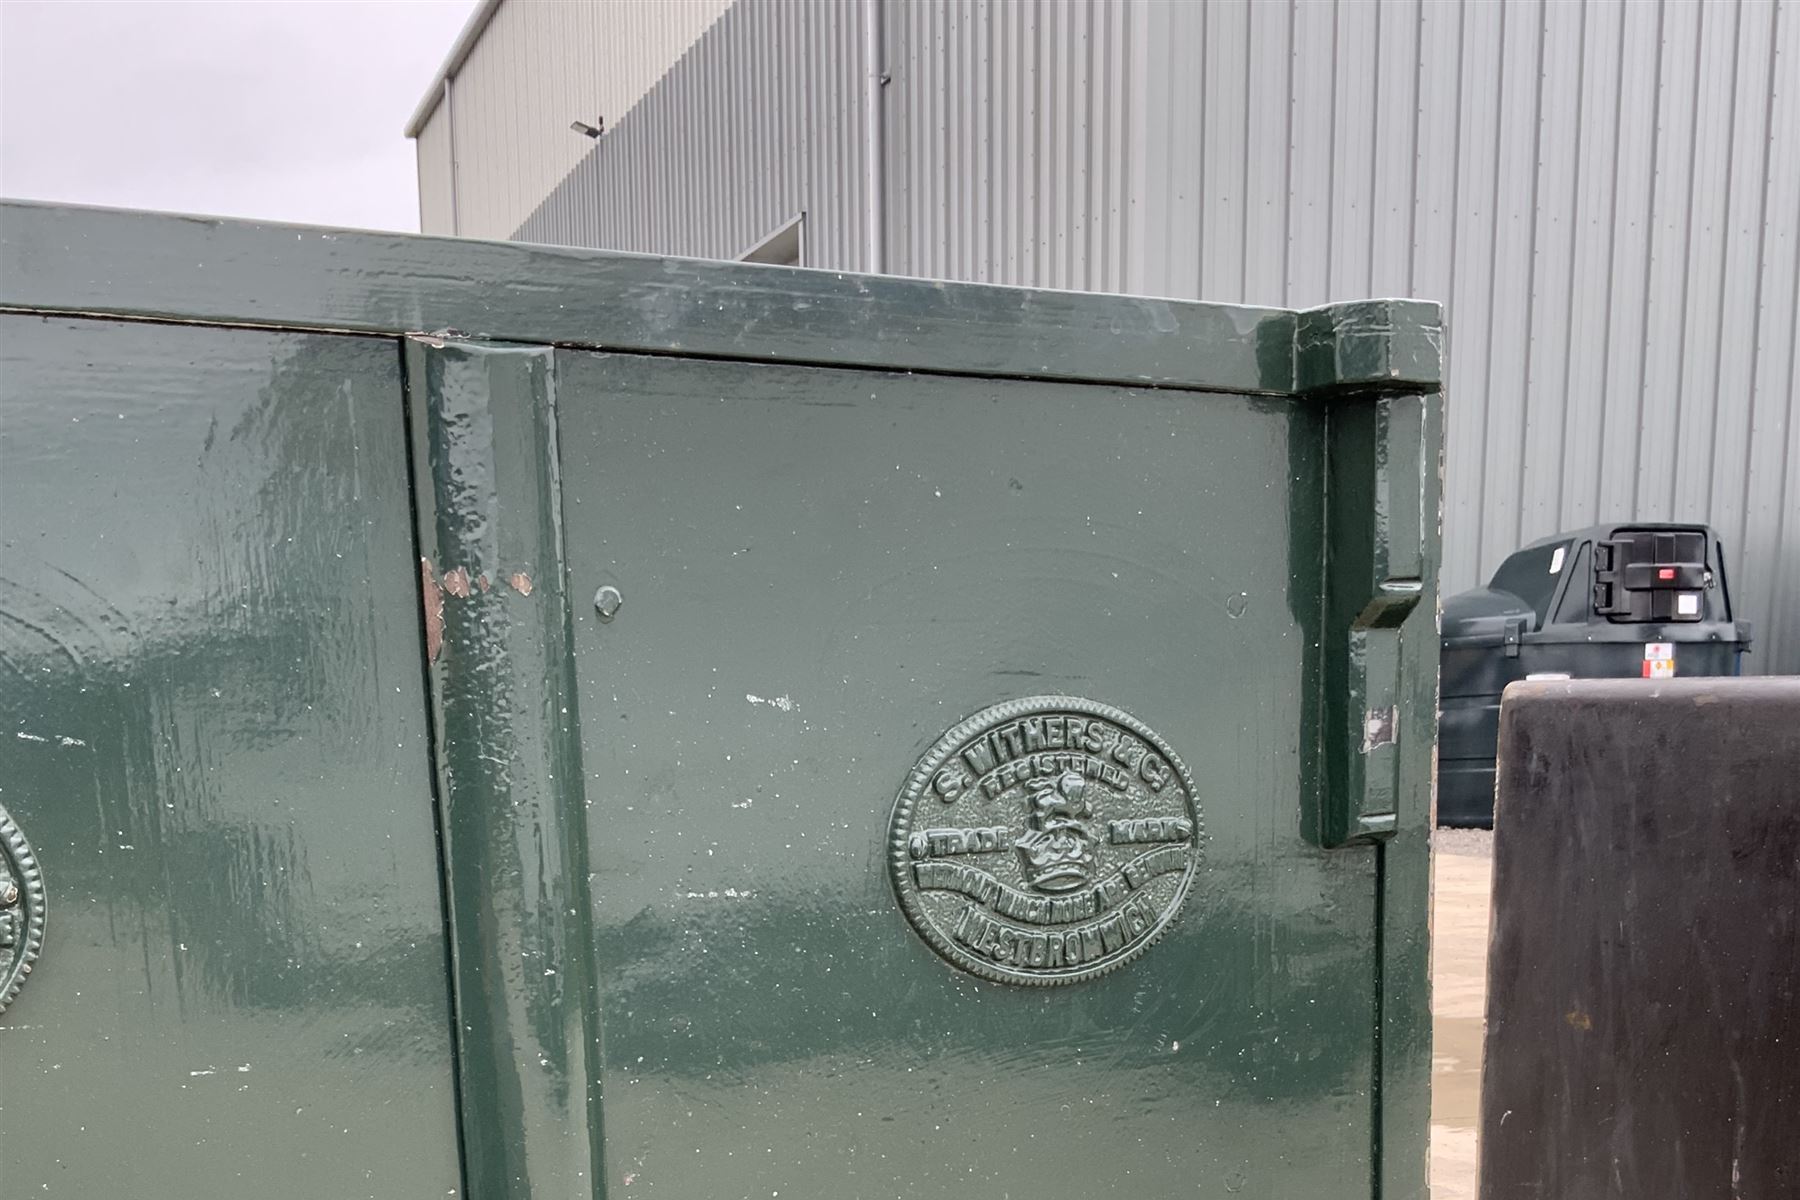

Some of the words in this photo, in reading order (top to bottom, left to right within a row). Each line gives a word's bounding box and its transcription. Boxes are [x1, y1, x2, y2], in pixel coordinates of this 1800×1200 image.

[961, 716, 1106, 775] WITHERS
[979, 752, 1130, 801] REGISTERED
[927, 827, 1009, 858] TRADE
[1108, 817, 1184, 845] MARK
